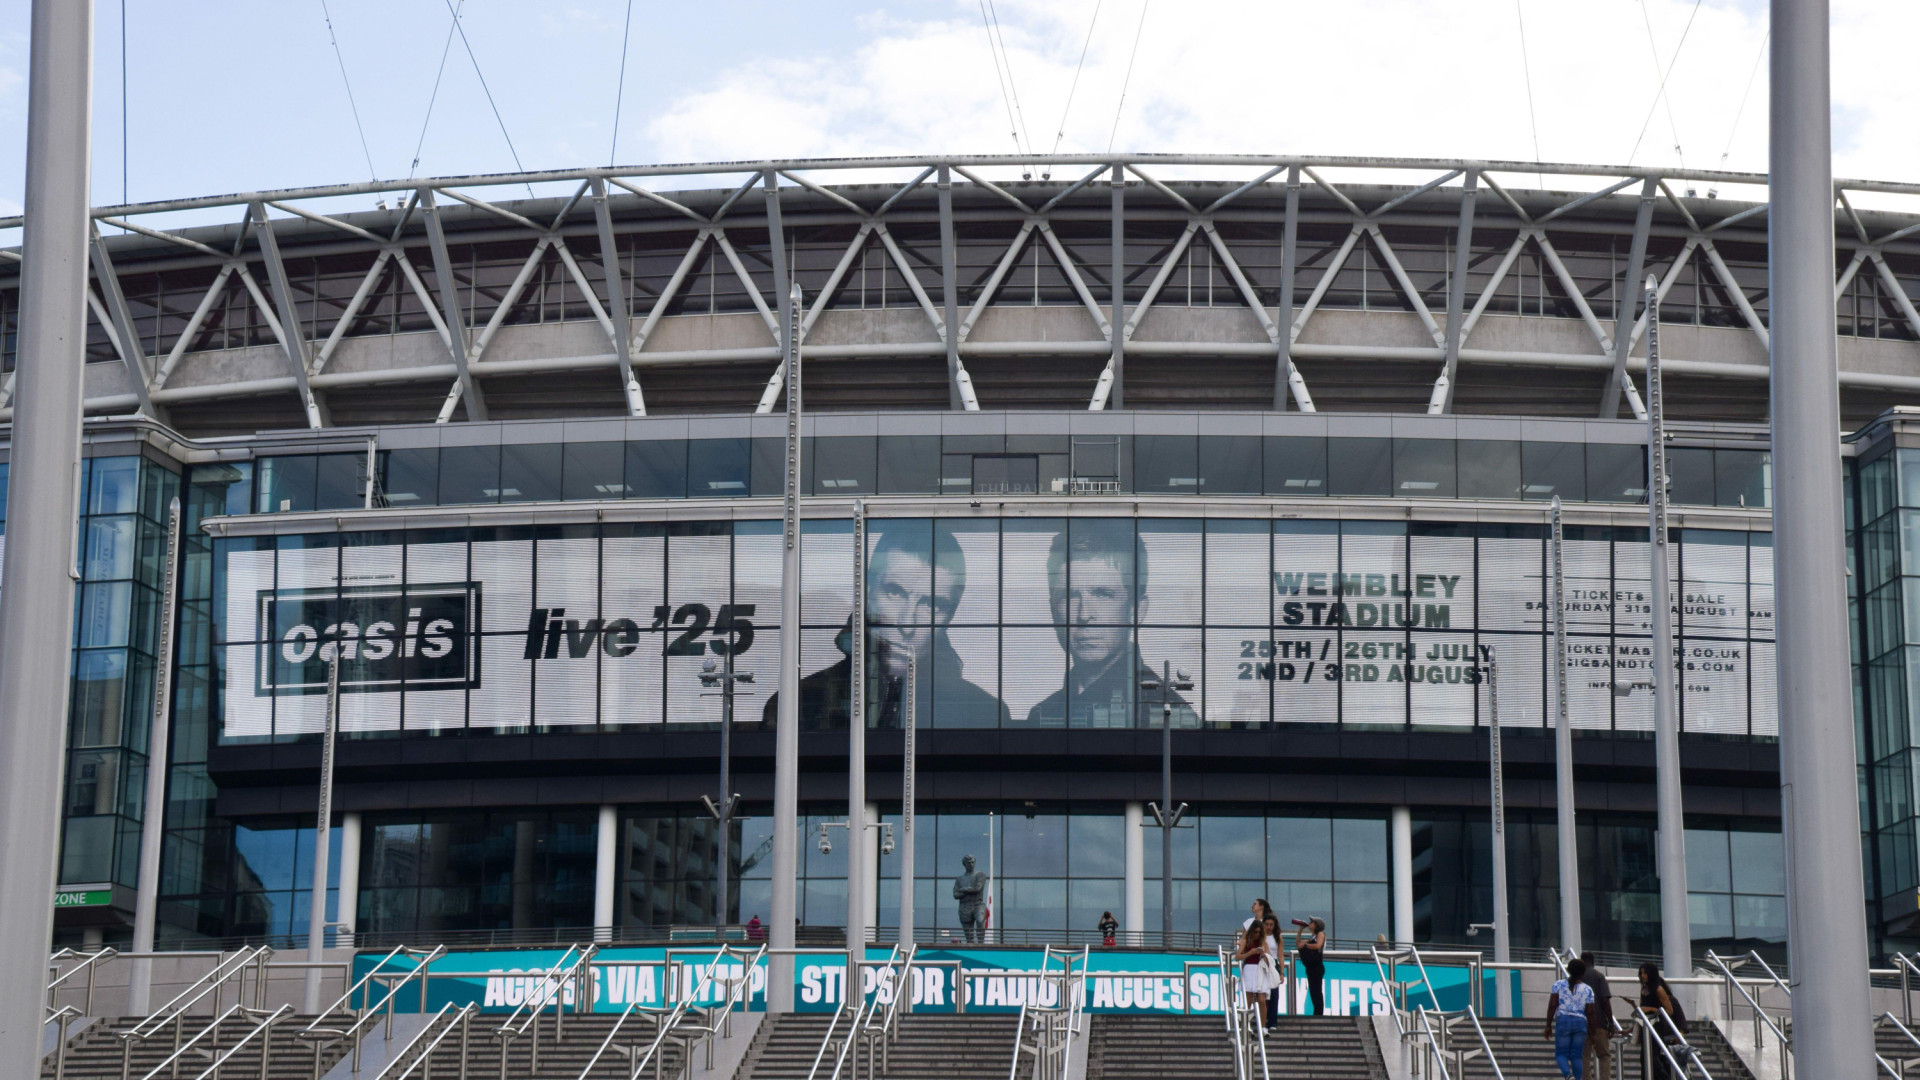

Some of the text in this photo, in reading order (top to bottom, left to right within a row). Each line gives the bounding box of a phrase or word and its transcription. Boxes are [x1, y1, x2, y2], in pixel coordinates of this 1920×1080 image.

[978, 482, 1008, 494] TH
[1273, 572, 1462, 599] WEMBLEY
[1573, 590, 1644, 601] TICKETS
[1685, 594, 1726, 604] SALE
[1282, 602, 1450, 628] STADIUM
[1525, 602, 1616, 612] SARDAY
[1624, 605, 1651, 613] 31S
[1671, 606, 1736, 616] AUGUST
[282, 607, 454, 663] oasis
[523, 603, 756, 660] live '25
[1240, 638, 1490, 662] 25TH / 26TH JULY
[1567, 644, 1741, 659] ICKETMASR.CO.UK
[1237, 661, 1296, 681] 2ND
[1303, 661, 1315, 684] /
[1324, 662, 1380, 682] 3RD
[1567, 657, 1734, 671] GIGSANDTORS.COM
[54, 892, 87, 905] ZONE
[484, 967, 600, 1007] ACCESS
[607, 966, 656, 1004] VIA
[662, 964, 768, 1003] OLYMP
[951, 968, 1086, 1007] STADIUM
[1093, 970, 1309, 1015] ACCESSITY
